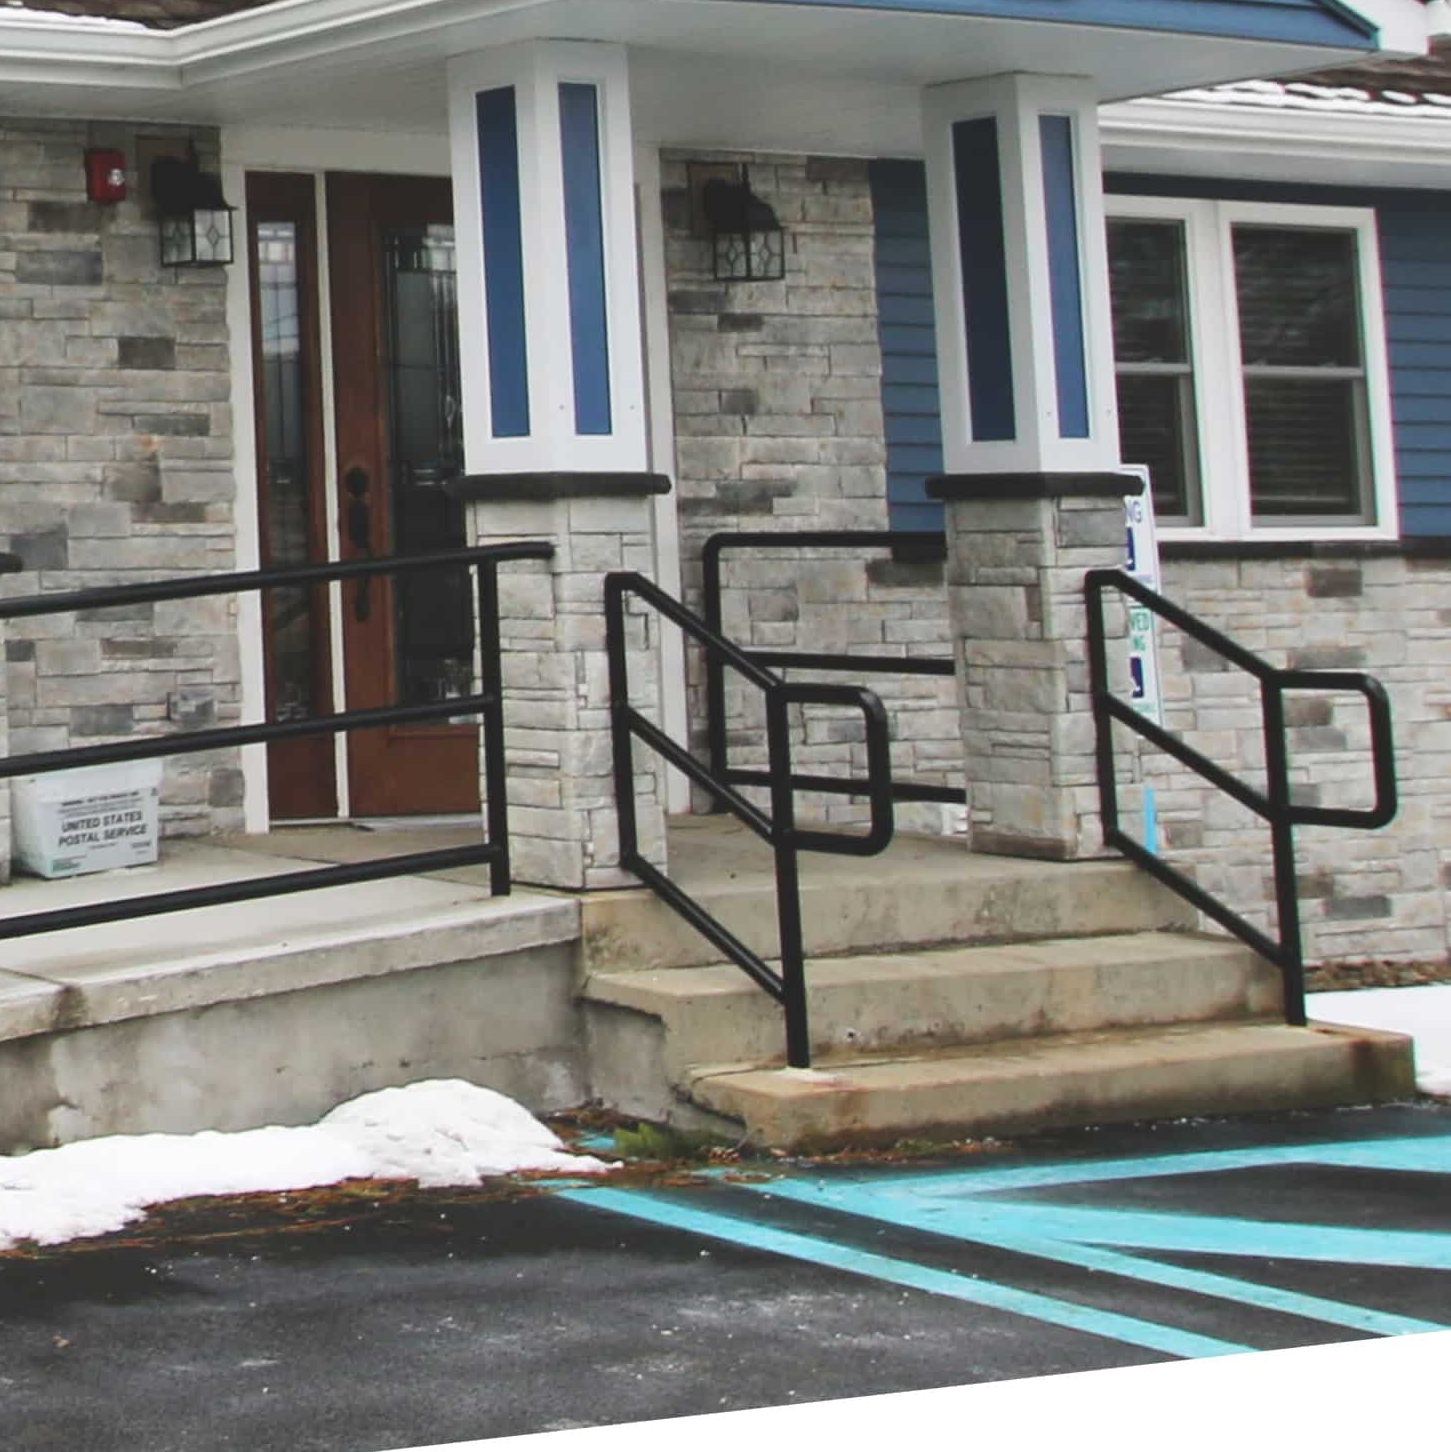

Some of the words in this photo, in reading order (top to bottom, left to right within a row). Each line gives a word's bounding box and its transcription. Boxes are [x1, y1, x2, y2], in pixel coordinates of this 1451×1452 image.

[61, 817, 101, 833] UNITED
[103, 810, 142, 827] STATES
[58, 831, 100, 847] POSTAL
[103, 823, 147, 840] SERVICE
